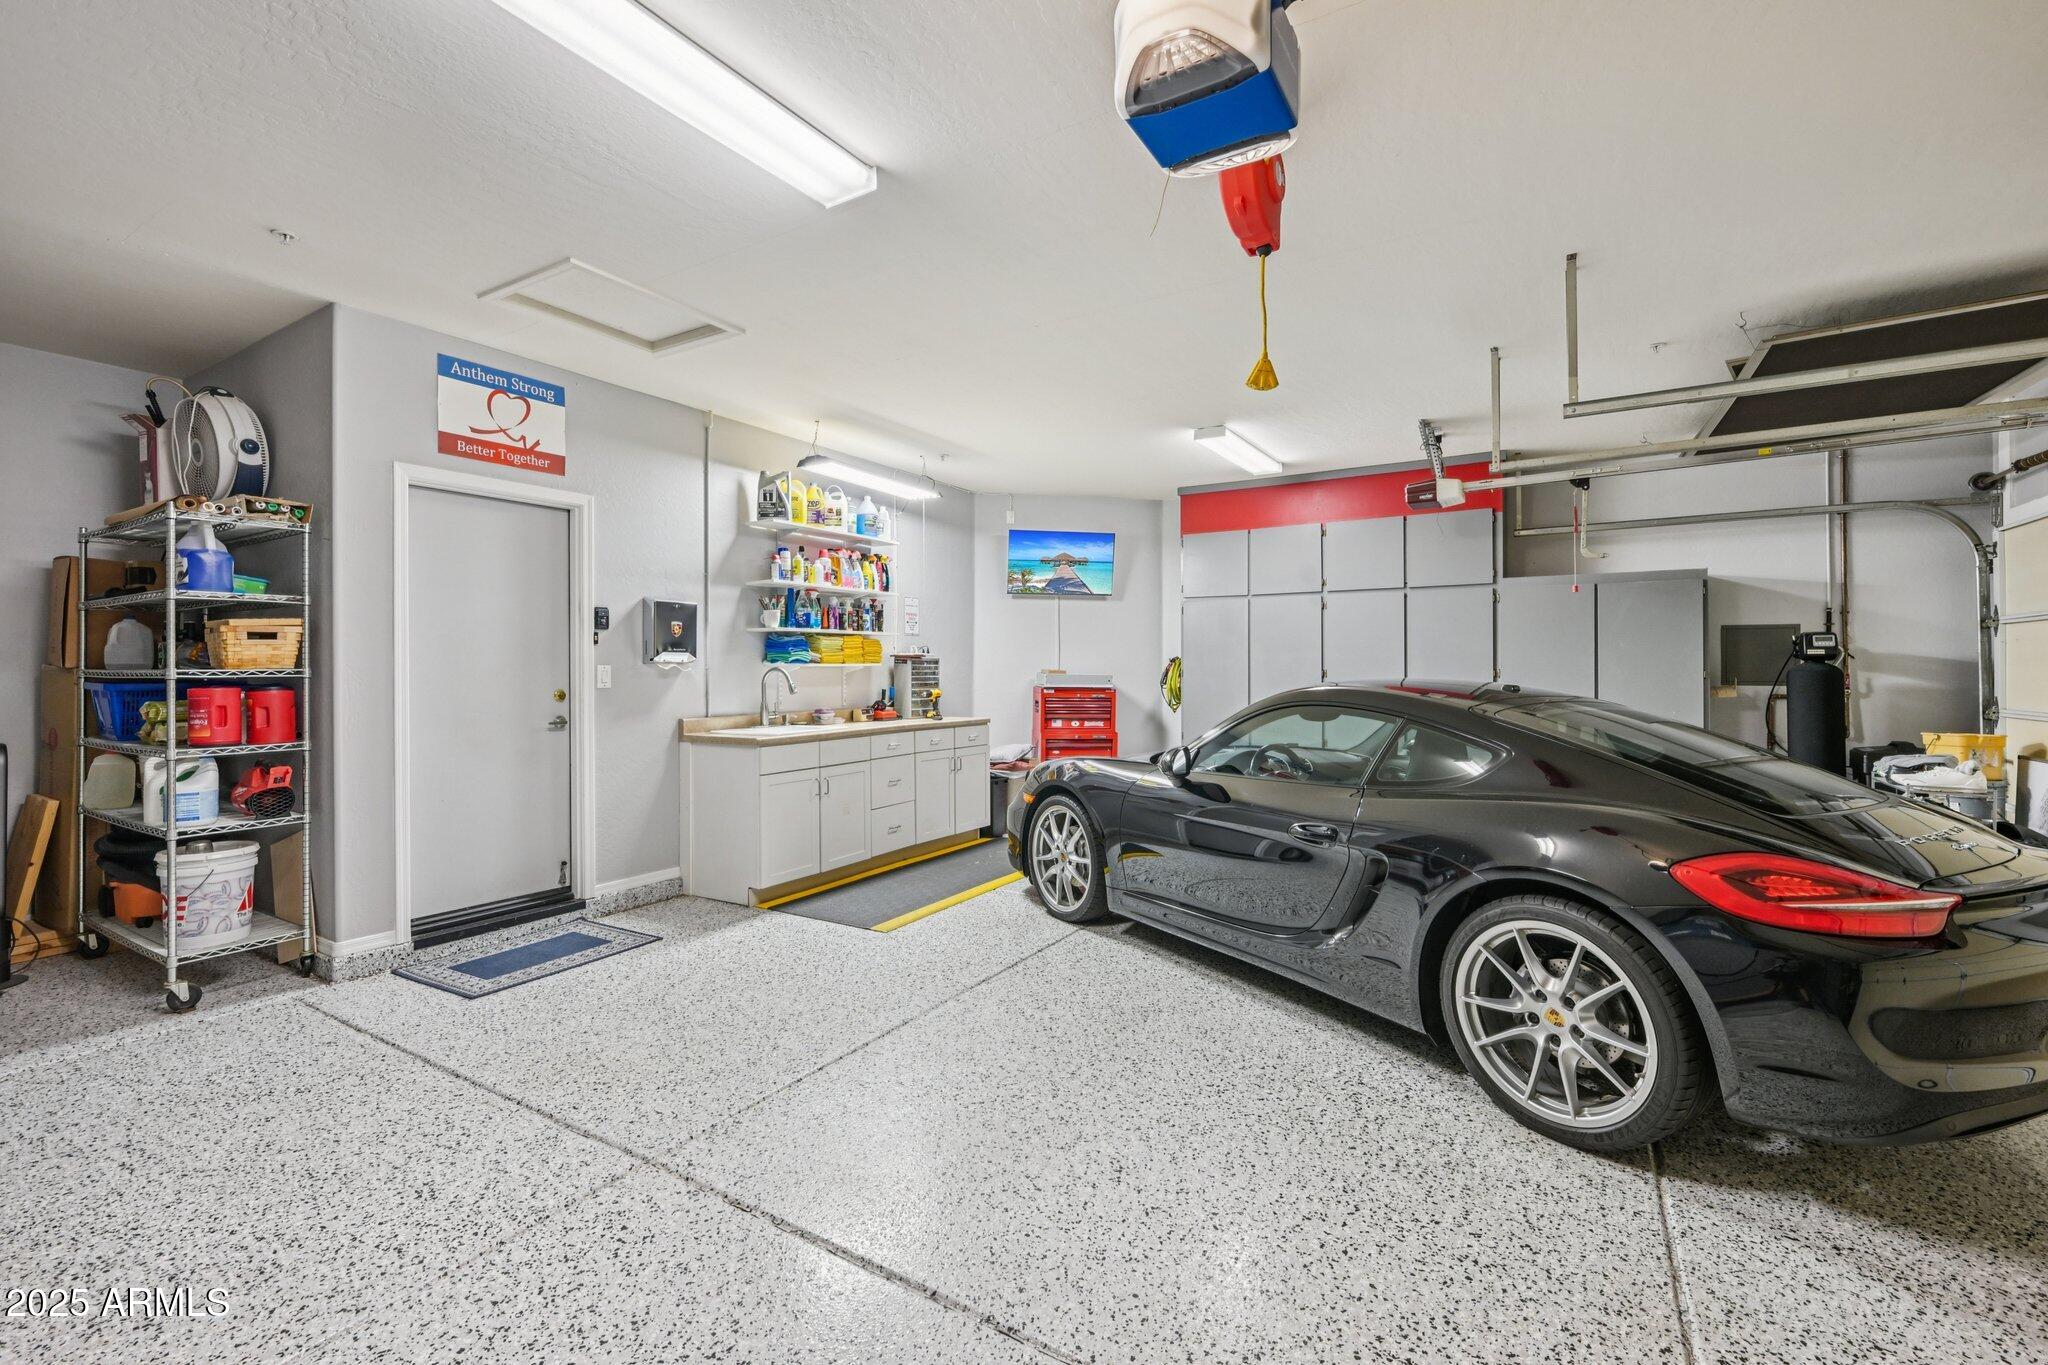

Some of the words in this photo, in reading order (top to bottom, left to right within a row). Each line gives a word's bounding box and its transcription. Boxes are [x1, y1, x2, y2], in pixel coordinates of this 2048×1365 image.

[451, 361, 507, 387] Anthem
[511, 377, 555, 402] Strong
[457, 440, 496, 458] Better
[498, 448, 551, 468] Together
